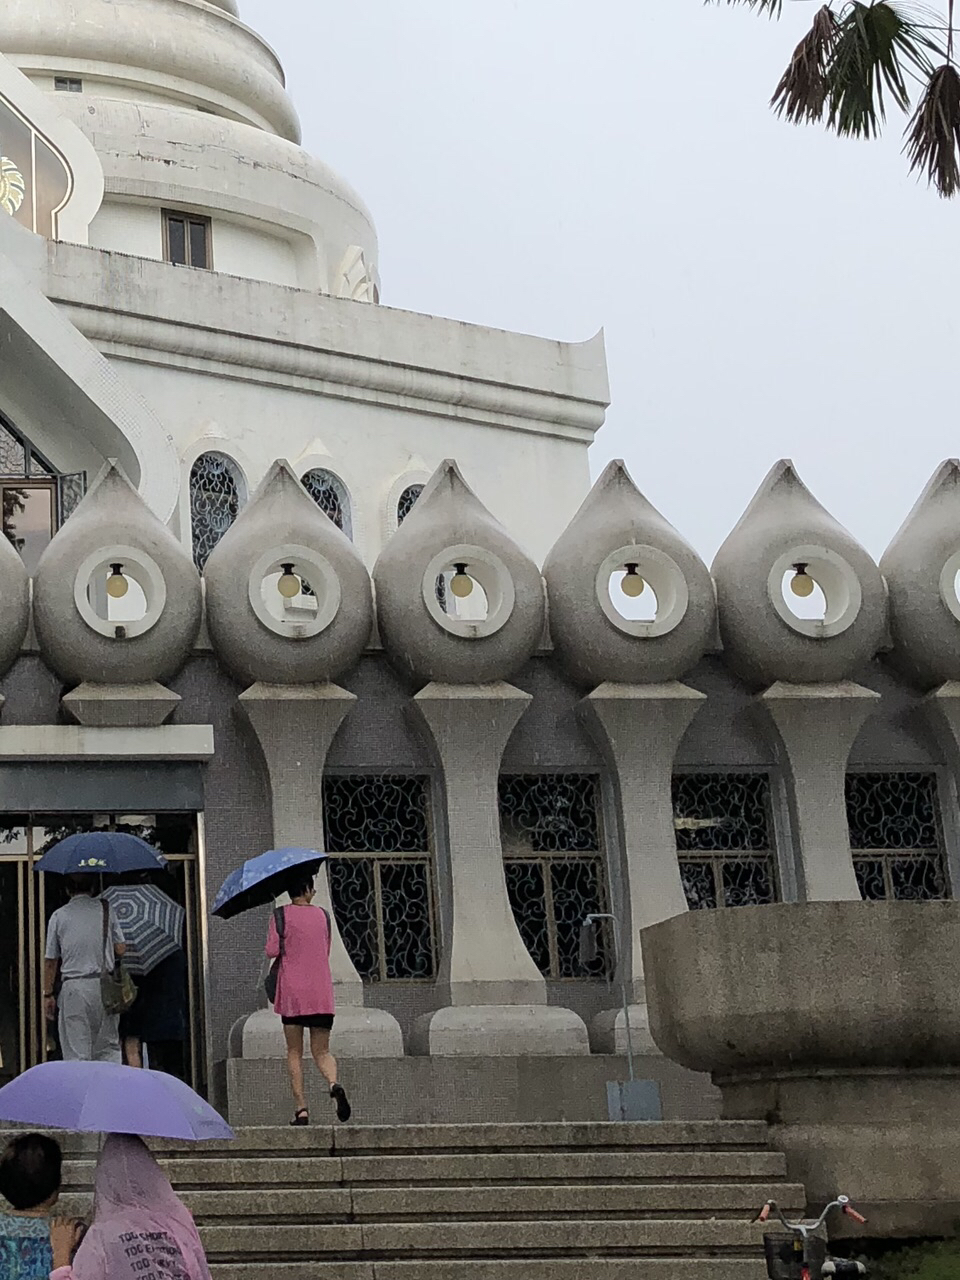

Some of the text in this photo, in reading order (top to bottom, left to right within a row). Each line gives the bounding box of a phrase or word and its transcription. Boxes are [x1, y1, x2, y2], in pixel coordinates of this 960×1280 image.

[119, 1232, 138, 1243] TOO
[125, 1244, 144, 1257] TOO
[130, 1258, 150, 1272] TOO
